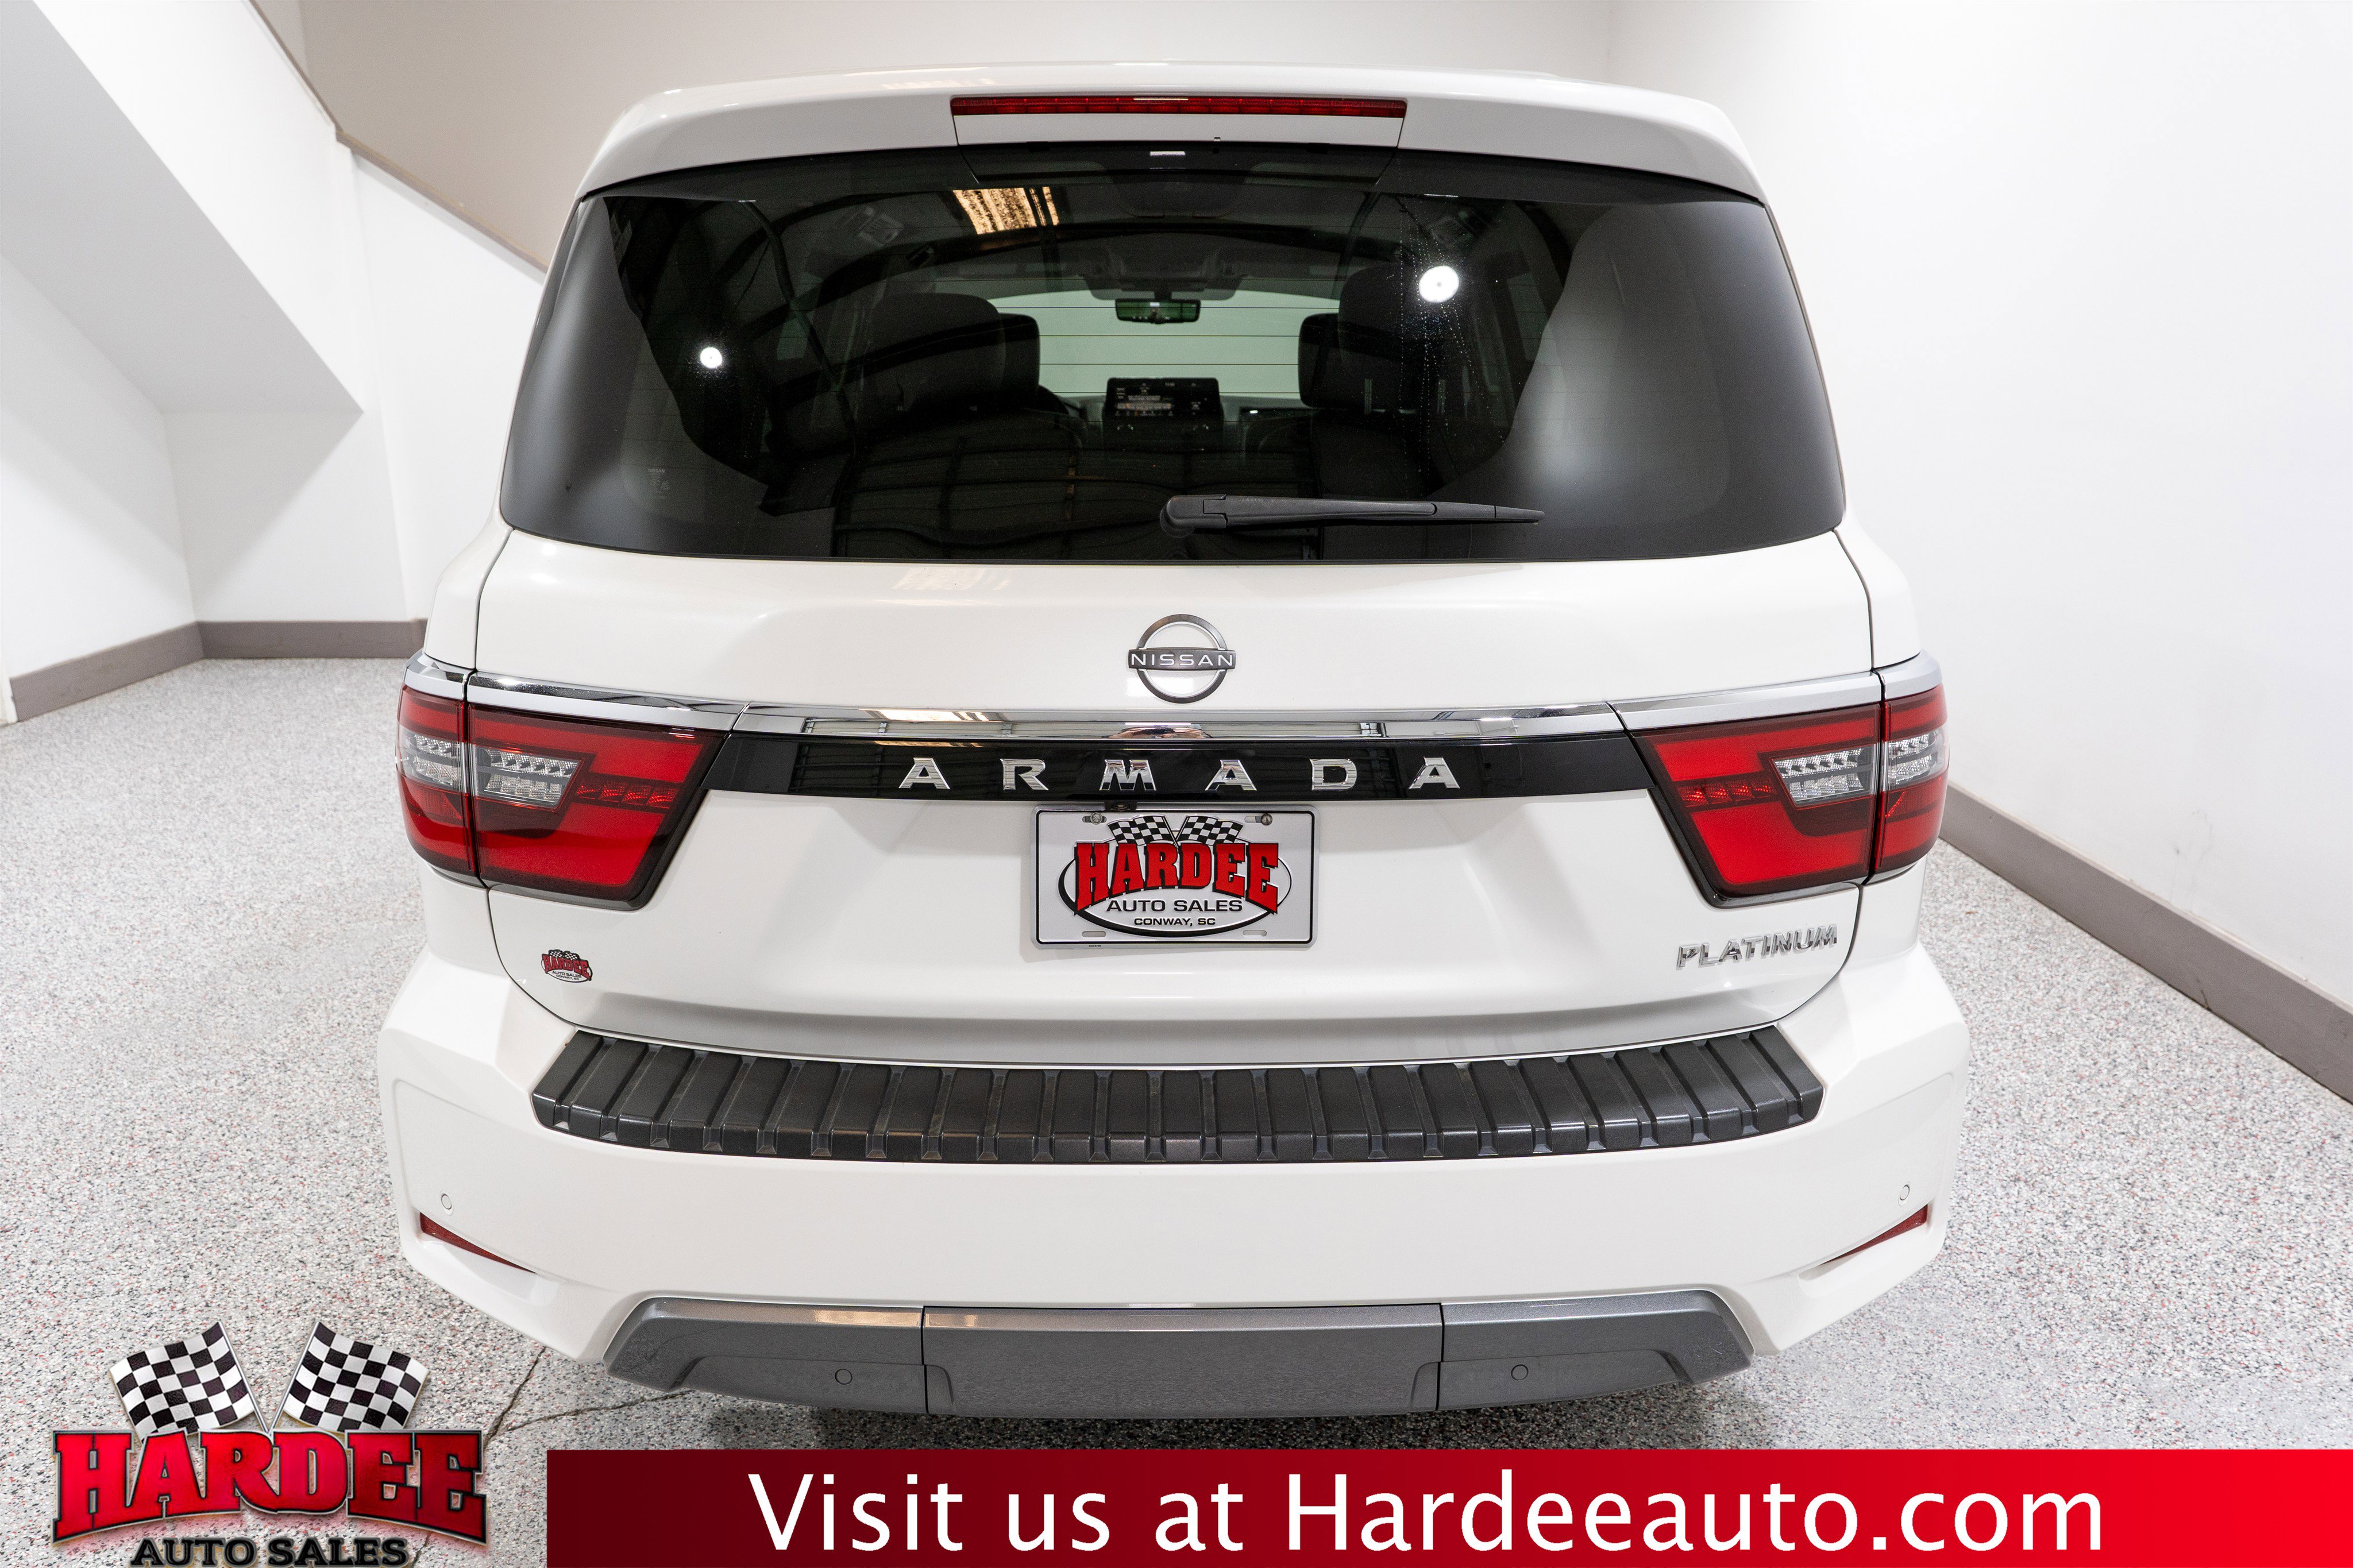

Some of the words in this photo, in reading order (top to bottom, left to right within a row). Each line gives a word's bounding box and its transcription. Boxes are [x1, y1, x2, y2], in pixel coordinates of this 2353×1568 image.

[1131, 654, 1233, 666] NISSAN
[898, 757, 1461, 791] ARMADA
[1074, 842, 1278, 914] HARDEE
[1106, 900, 1166, 912] AUTO
[1174, 900, 1243, 912] SALES
[1134, 918, 1193, 926] CONWAY,
[1676, 924, 1837, 969] PLATINUM
[542, 954, 591, 980] HARDEE
